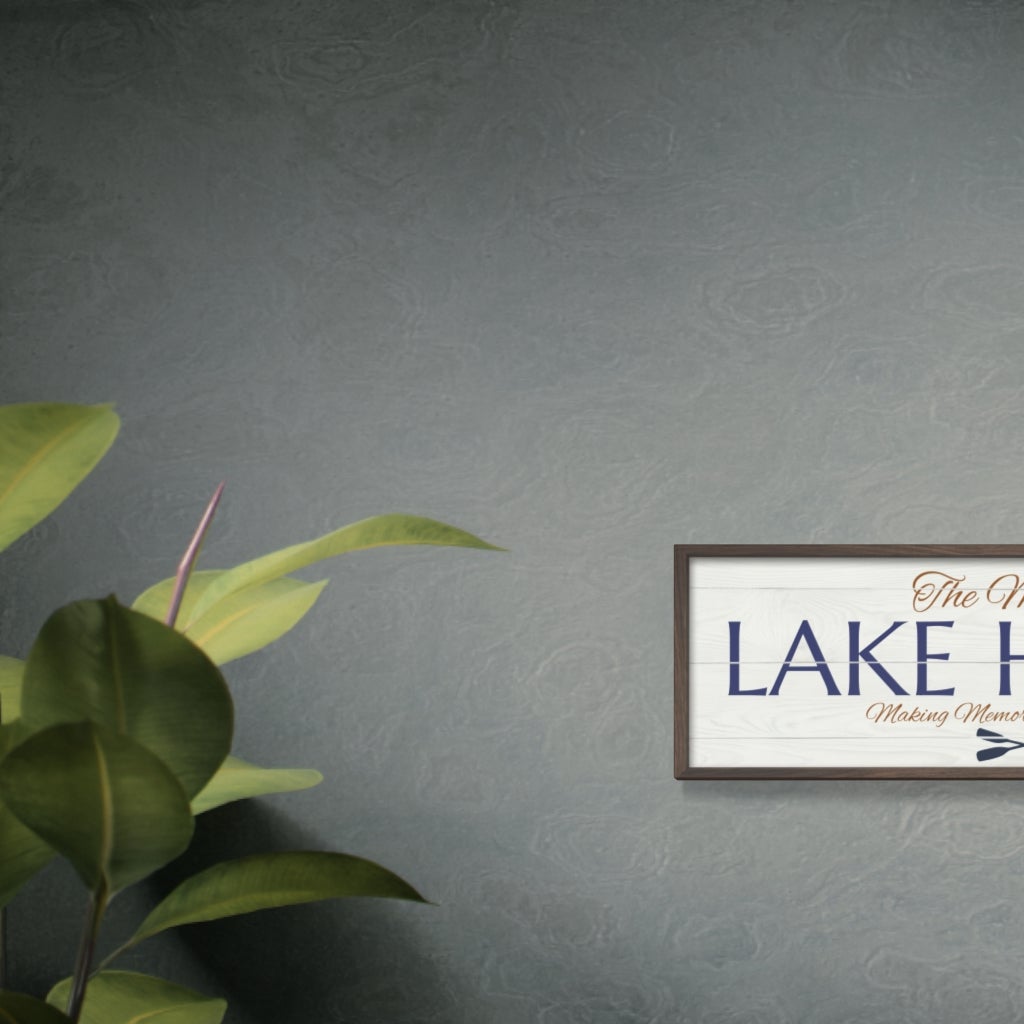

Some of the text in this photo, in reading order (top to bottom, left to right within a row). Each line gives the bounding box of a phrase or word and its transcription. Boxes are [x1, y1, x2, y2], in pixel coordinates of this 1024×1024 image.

[911, 571, 979, 613] The
[727, 619, 956, 697] LAKE
[865, 703, 949, 728] Making
